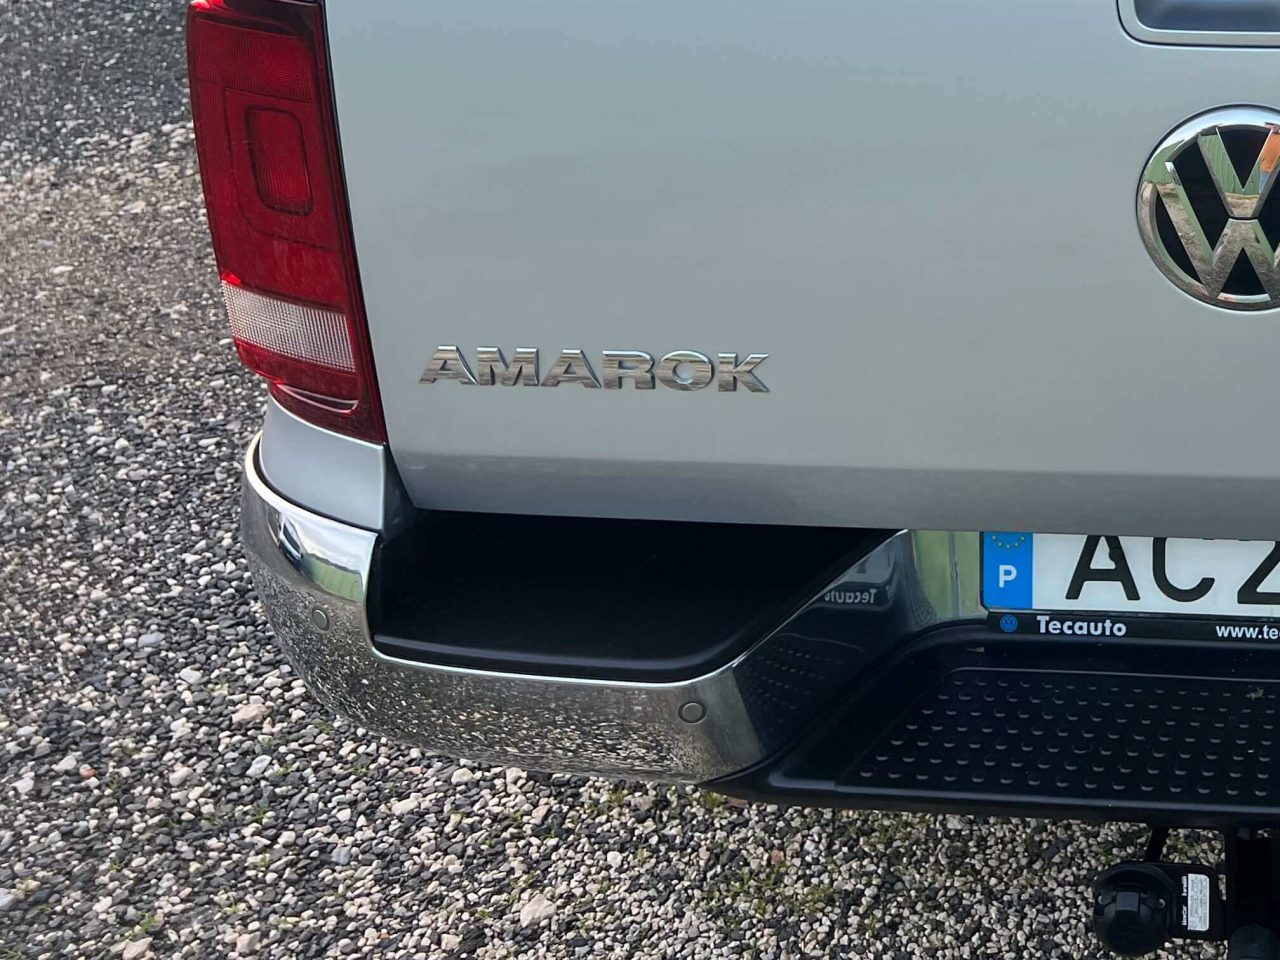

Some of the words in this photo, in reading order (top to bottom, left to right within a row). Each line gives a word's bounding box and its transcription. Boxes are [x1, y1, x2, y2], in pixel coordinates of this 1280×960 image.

[416, 344, 770, 393] AMAROK
[998, 565, 1018, 588] P
[1036, 615, 1127, 637] Tecauto
